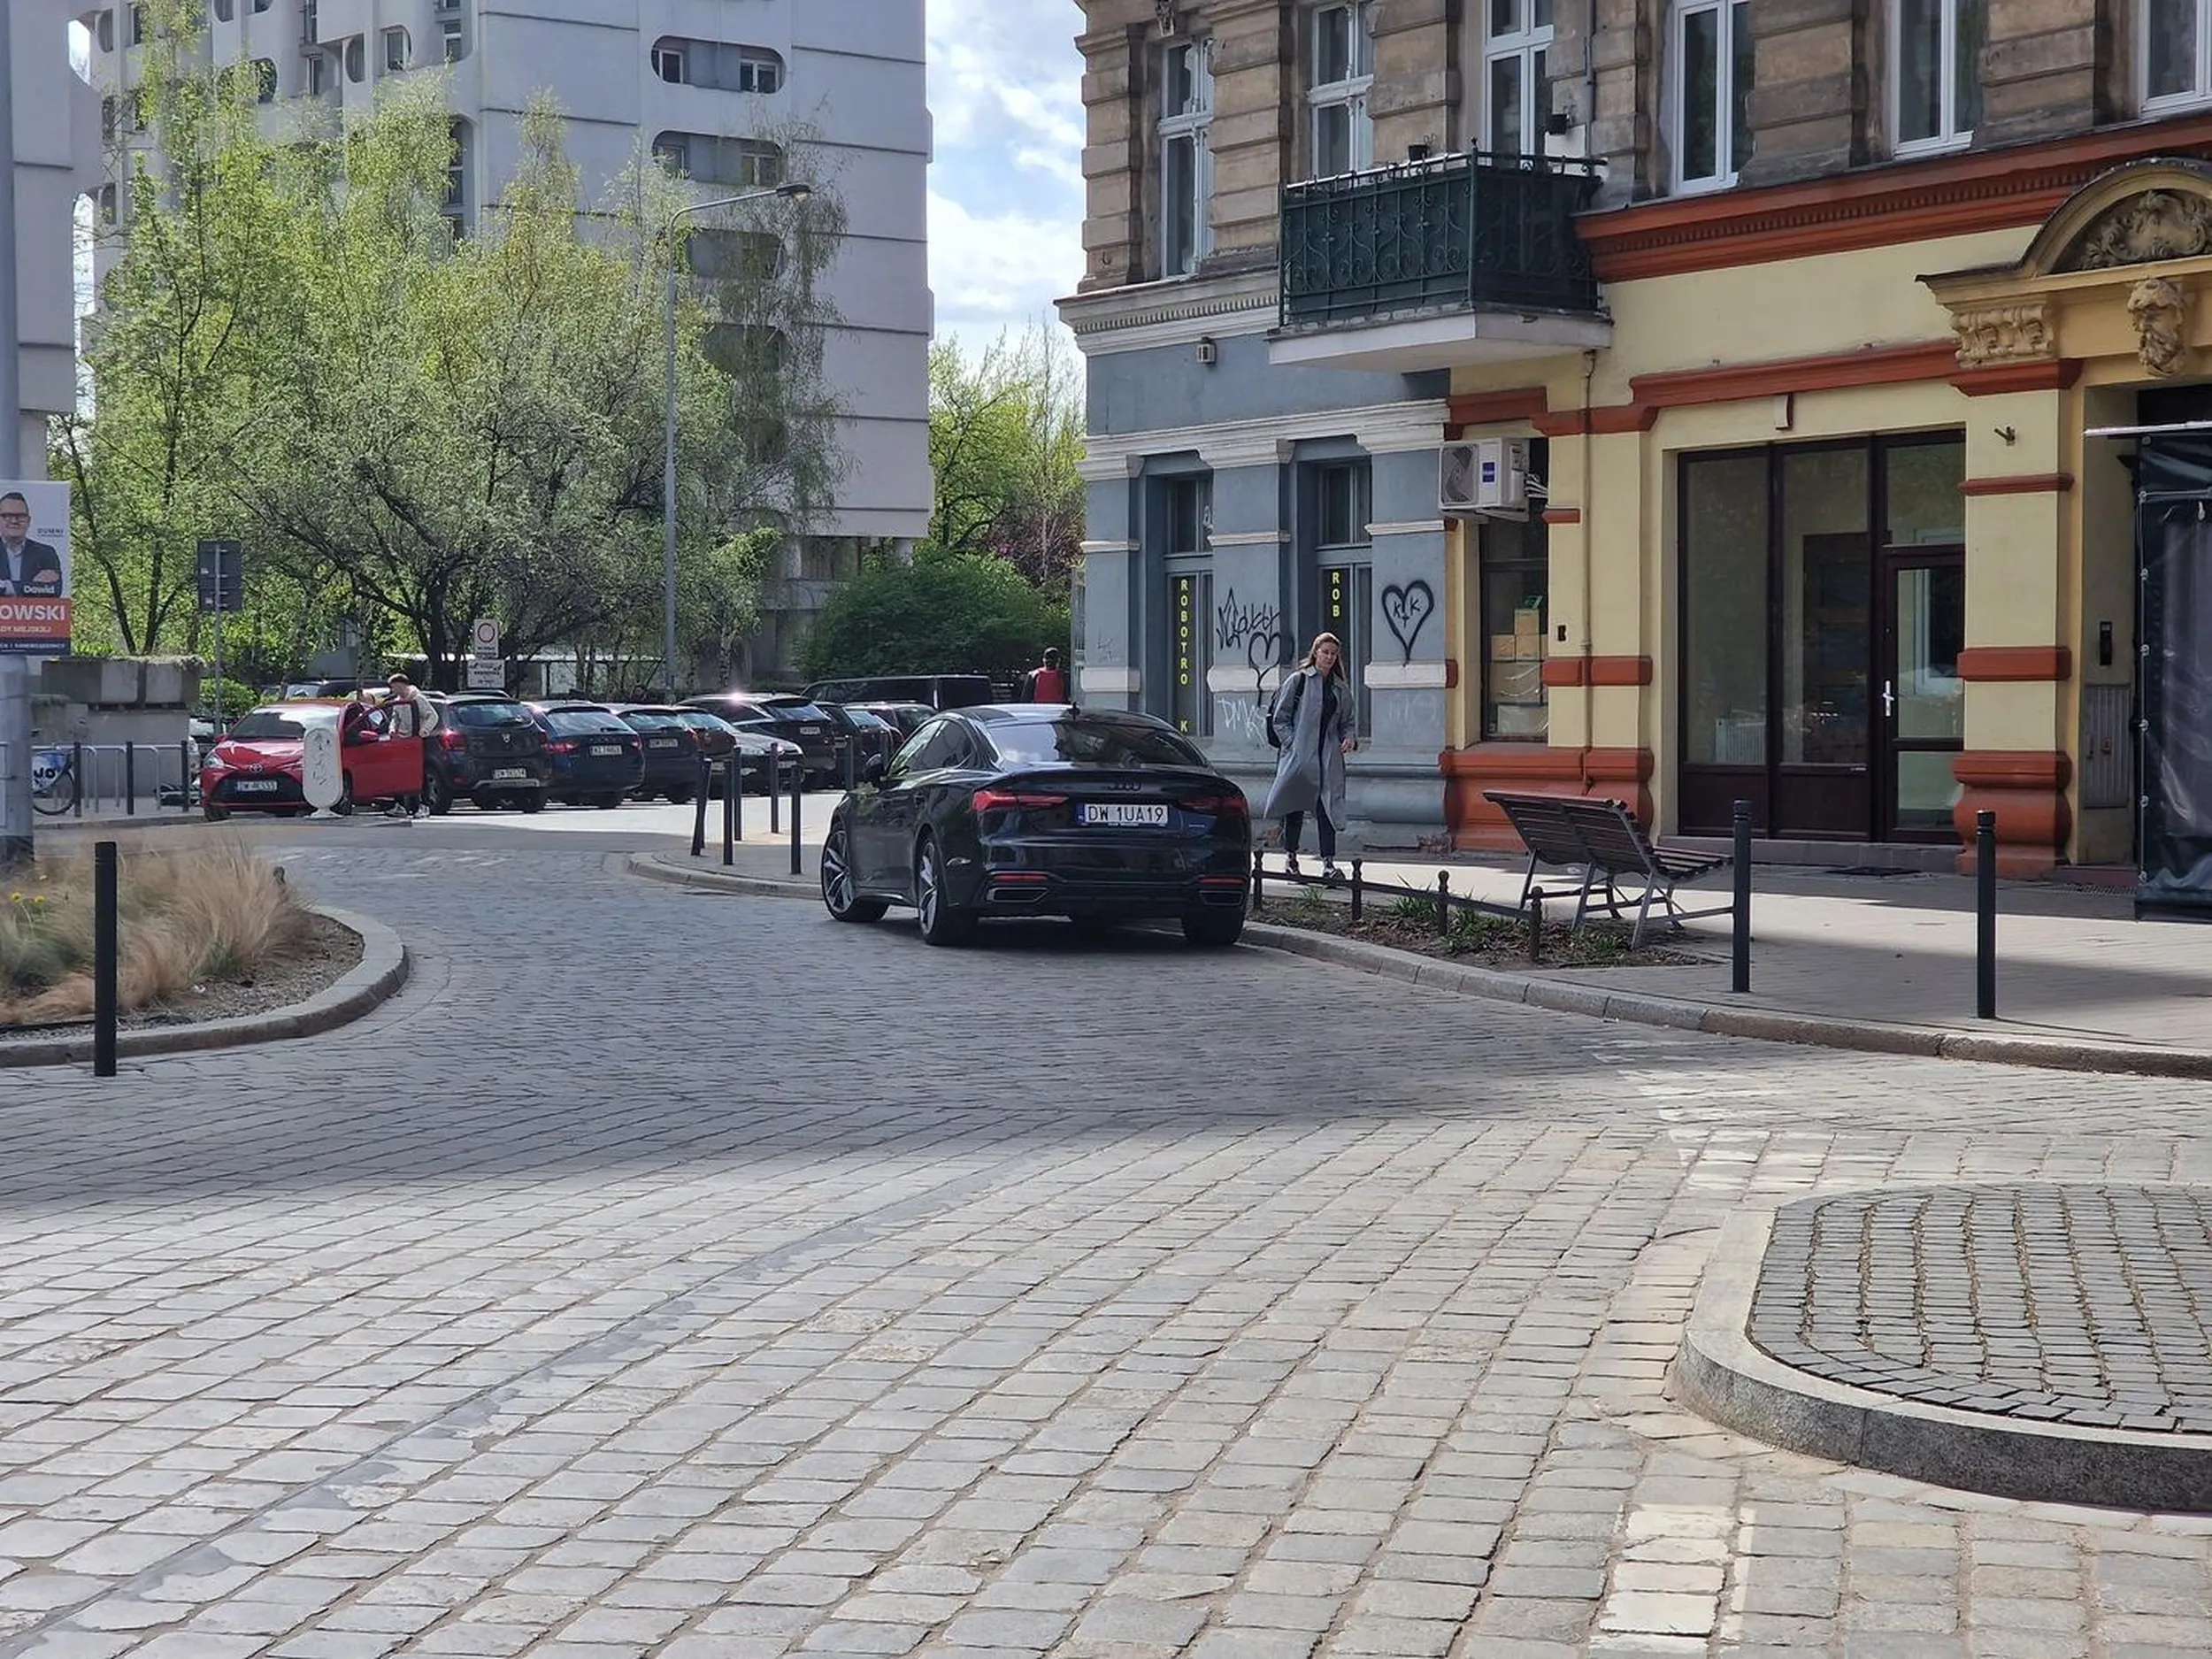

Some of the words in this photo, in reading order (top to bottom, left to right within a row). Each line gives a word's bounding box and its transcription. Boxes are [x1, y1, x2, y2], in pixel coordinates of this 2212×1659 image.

[24, 585, 55, 594] Dawid
[1332, 572, 1340, 617] ROB
[0, 604, 65, 620] OWSKI
[1088, 806, 1108, 821] DW
[1118, 807, 1164, 822] 1UA19
